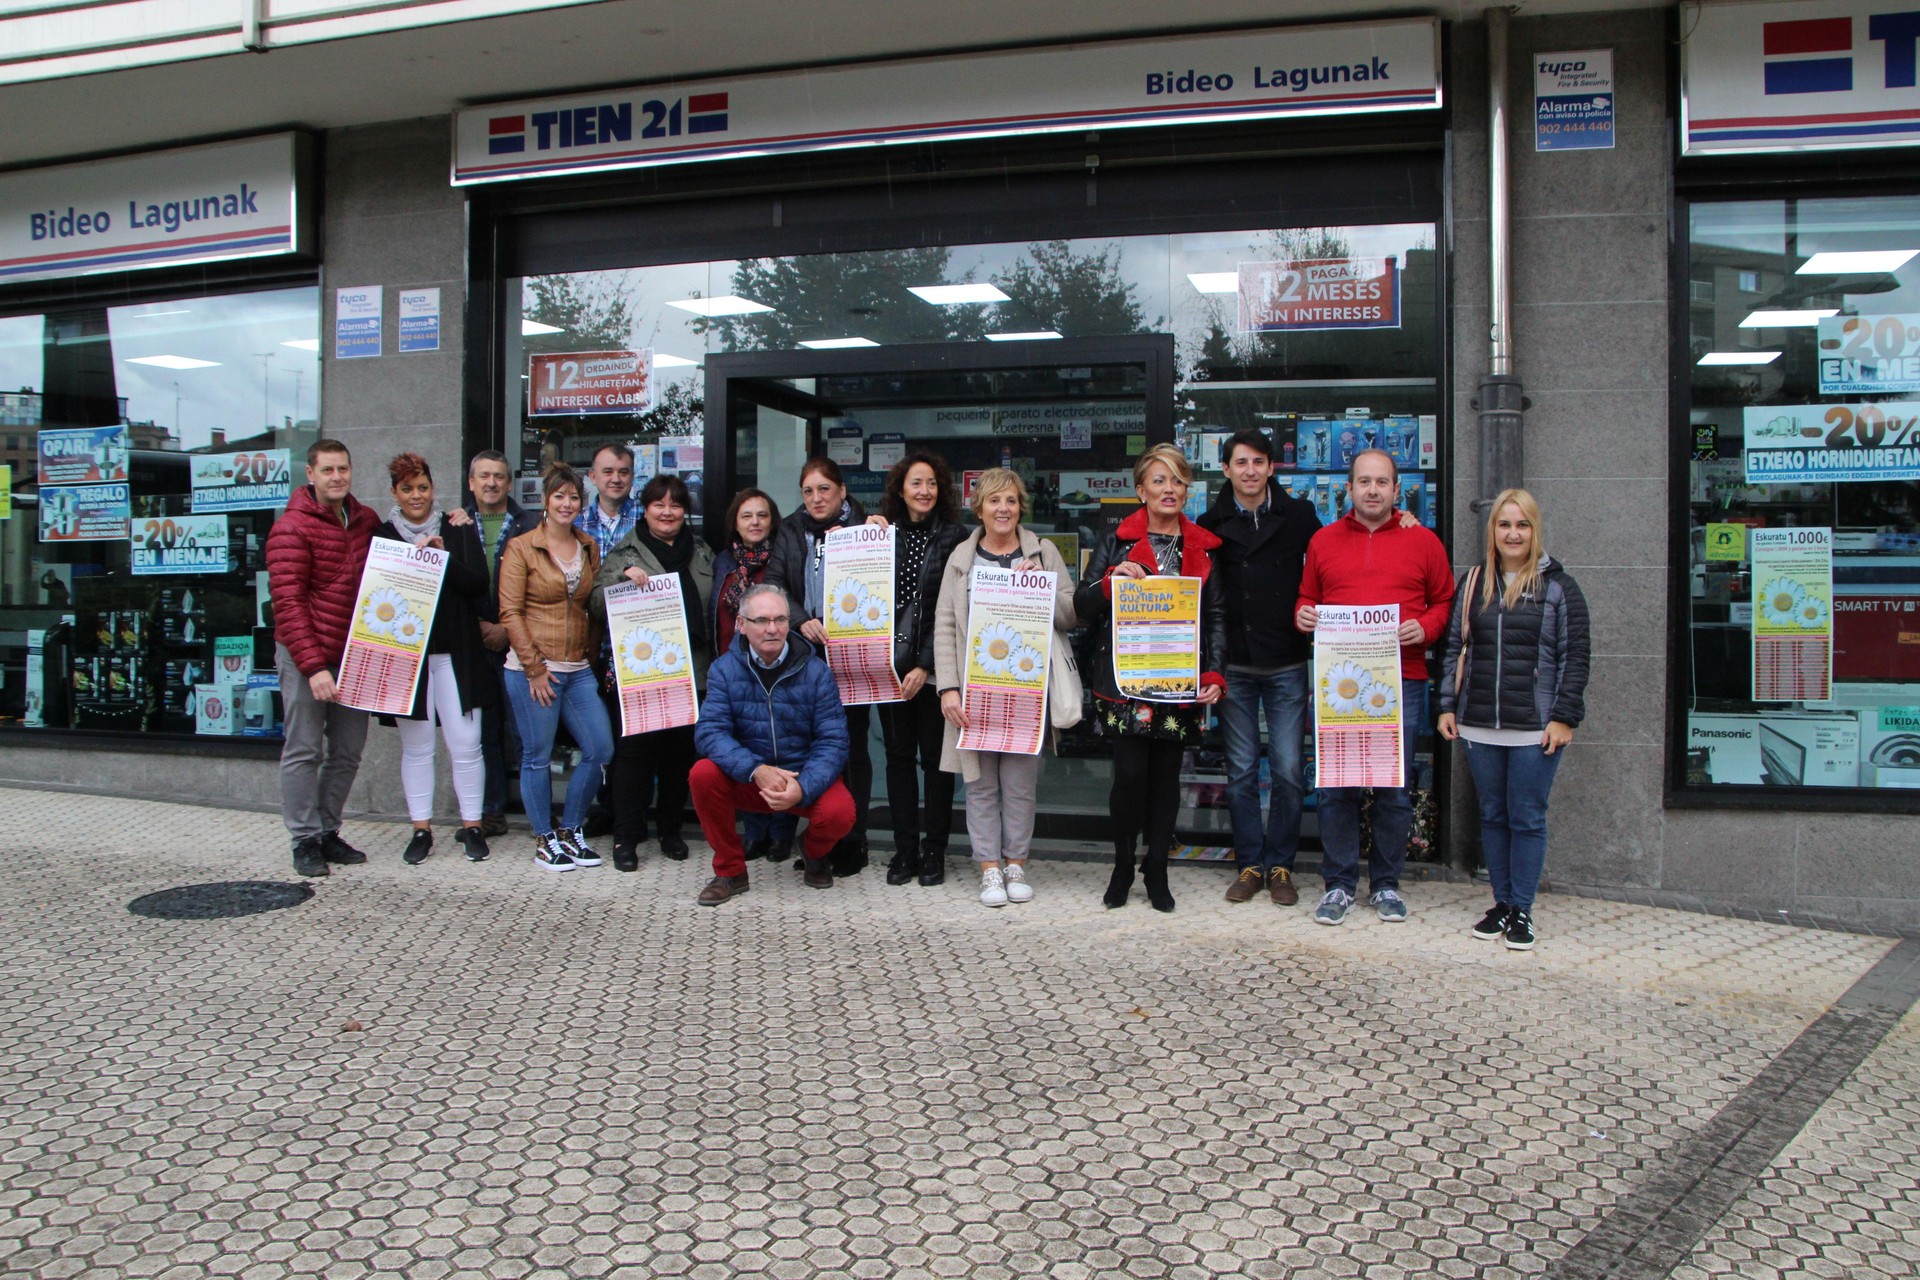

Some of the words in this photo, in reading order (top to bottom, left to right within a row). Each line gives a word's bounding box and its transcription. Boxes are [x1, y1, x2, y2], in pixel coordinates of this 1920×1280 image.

[1146, 69, 1234, 95] Bideo
[1253, 56, 1390, 92] Lagunak
[1538, 61, 1587, 76] tyco
[1560, 72, 1598, 80] Integrated
[1580, 78, 1610, 87] Security
[1539, 101, 1591, 112] Alarma
[1585, 109, 1611, 118] policía
[531, 102, 632, 150] TIEN
[642, 97, 682, 139] 21
[1539, 123, 1561, 134] 902
[1563, 122, 1586, 132] 444
[1588, 121, 1612, 132] 440
[30, 207, 111, 240] Bideo
[129, 183, 258, 232] Lagunak
[1311, 267, 1348, 280] PAGA
[1259, 271, 1302, 303] 12
[1307, 282, 1381, 301] MESES
[339, 294, 367, 305] tyco
[402, 295, 426, 305] tyco
[1260, 309, 1288, 322] SIN
[1294, 306, 1381, 321] INTERESES
[338, 322, 368, 331] Alarma
[401, 320, 428, 328] Alarma
[585, 360, 634, 374] ORDAINDU
[1822, 358, 1862, 382] EN
[545, 361, 580, 391] 12
[579, 378, 640, 389] HILABETETAN
[541, 395, 602, 408] INTERESIK
[1749, 450, 1805, 471] ETXEKO
[224, 452, 290, 484] -20%
[1084, 477, 1131, 488] Tefal
[80, 486, 126, 503] REGALO
[194, 488, 226, 503] ETXEKO
[227, 483, 289, 501] HORNIDURETAN
[133, 519, 196, 549] -20%
[828, 532, 853, 542] Eskuratu
[854, 528, 891, 543] 1.000€
[1755, 533, 1787, 541] Eskuratu
[1788, 531, 1828, 544] 1.000€
[134, 550, 156, 566] EN
[162, 547, 227, 566] MENAJE
[374, 541, 404, 553] Eskuratu
[406, 546, 444, 567] 1.000€
[976, 570, 1009, 582] Eskuratu
[1010, 573, 1053, 590] 1.000€
[608, 585, 638, 596] Eskuratu
[1119, 592, 1173, 603] GUZTIETAN
[1119, 603, 1171, 613] KULTURA
[1834, 601, 1880, 612] SMART
[1883, 601, 1901, 611] TV
[1318, 610, 1351, 620] Eskuratu
[1352, 609, 1396, 625] 1.000€
[1691, 727, 1752, 739] Panasonic
